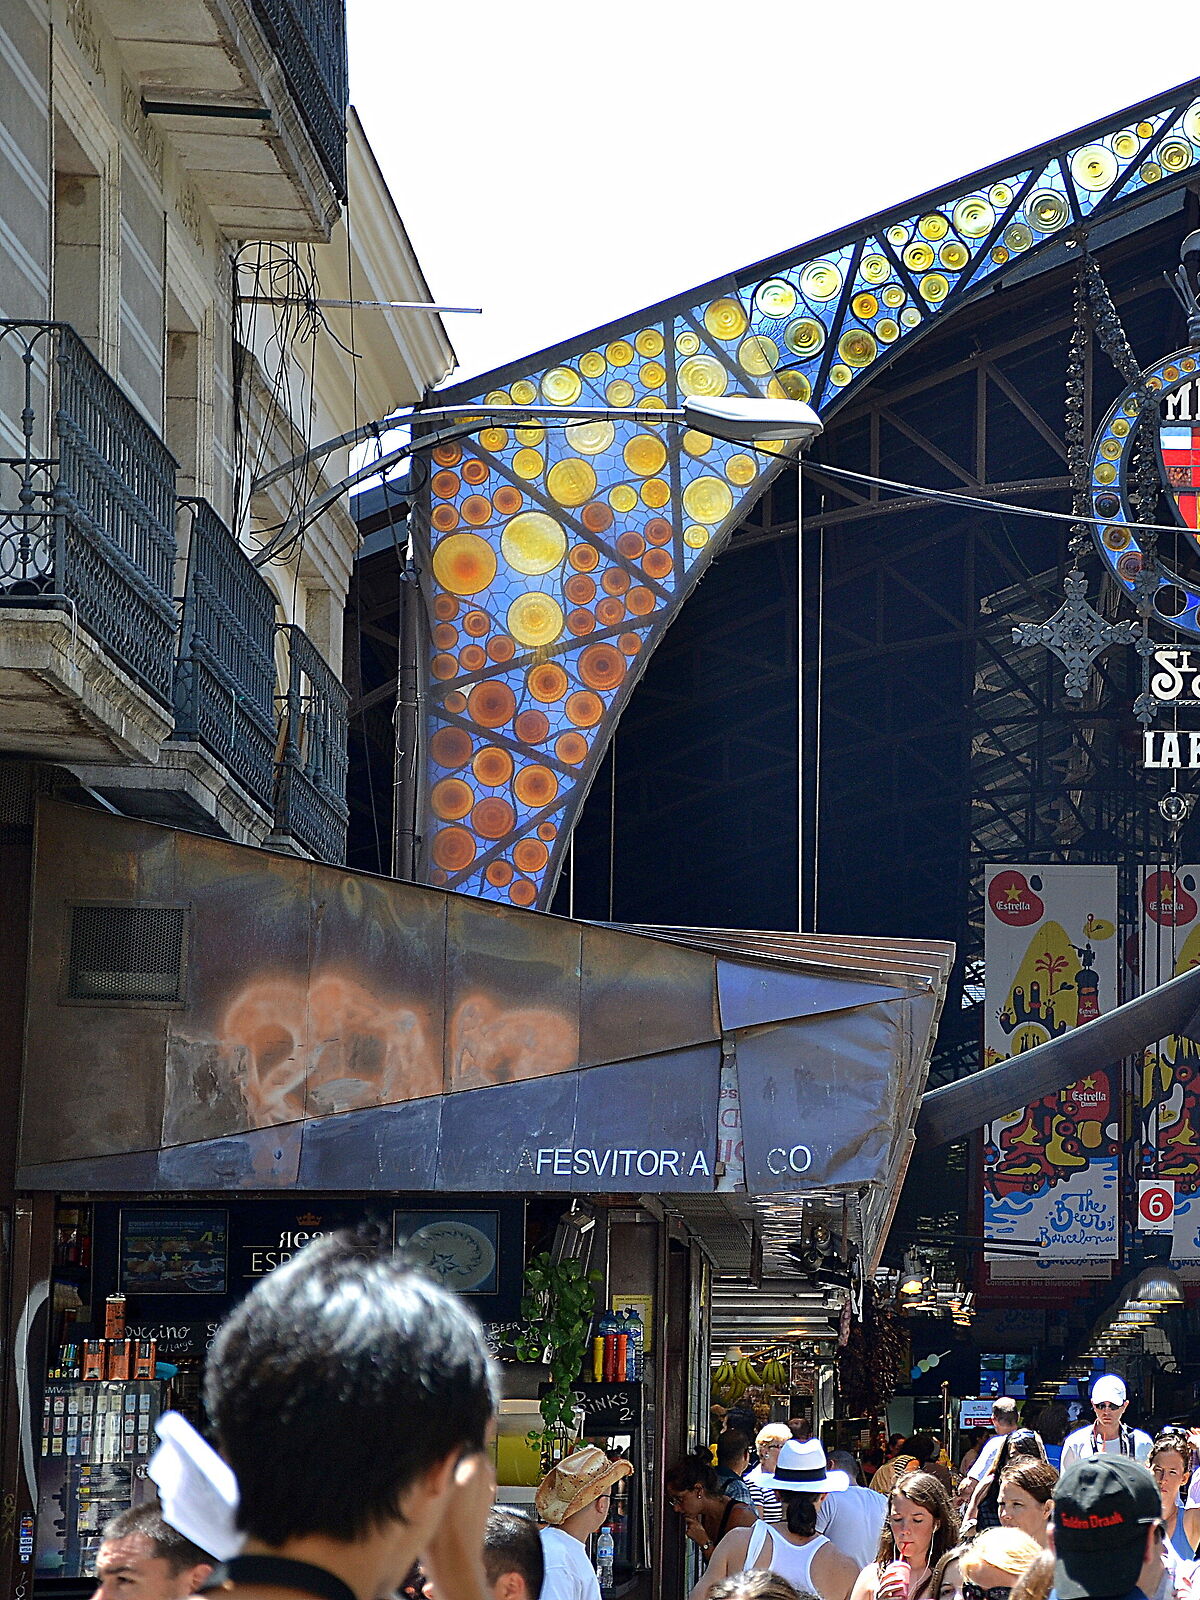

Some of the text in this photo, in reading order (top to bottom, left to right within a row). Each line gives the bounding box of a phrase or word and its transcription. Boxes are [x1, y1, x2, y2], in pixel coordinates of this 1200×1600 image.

[1144, 732, 1181, 768] LA
[996, 901, 1030, 910] Estrella
[1150, 901, 1184, 910] Etrela
[1072, 1091, 1106, 1101] Estrella
[1061, 1189, 1106, 1213] The
[1149, 1193, 1164, 1217] 6
[1050, 1200, 1106, 1232] Beer
[577, 1392, 629, 1414] RINKS
